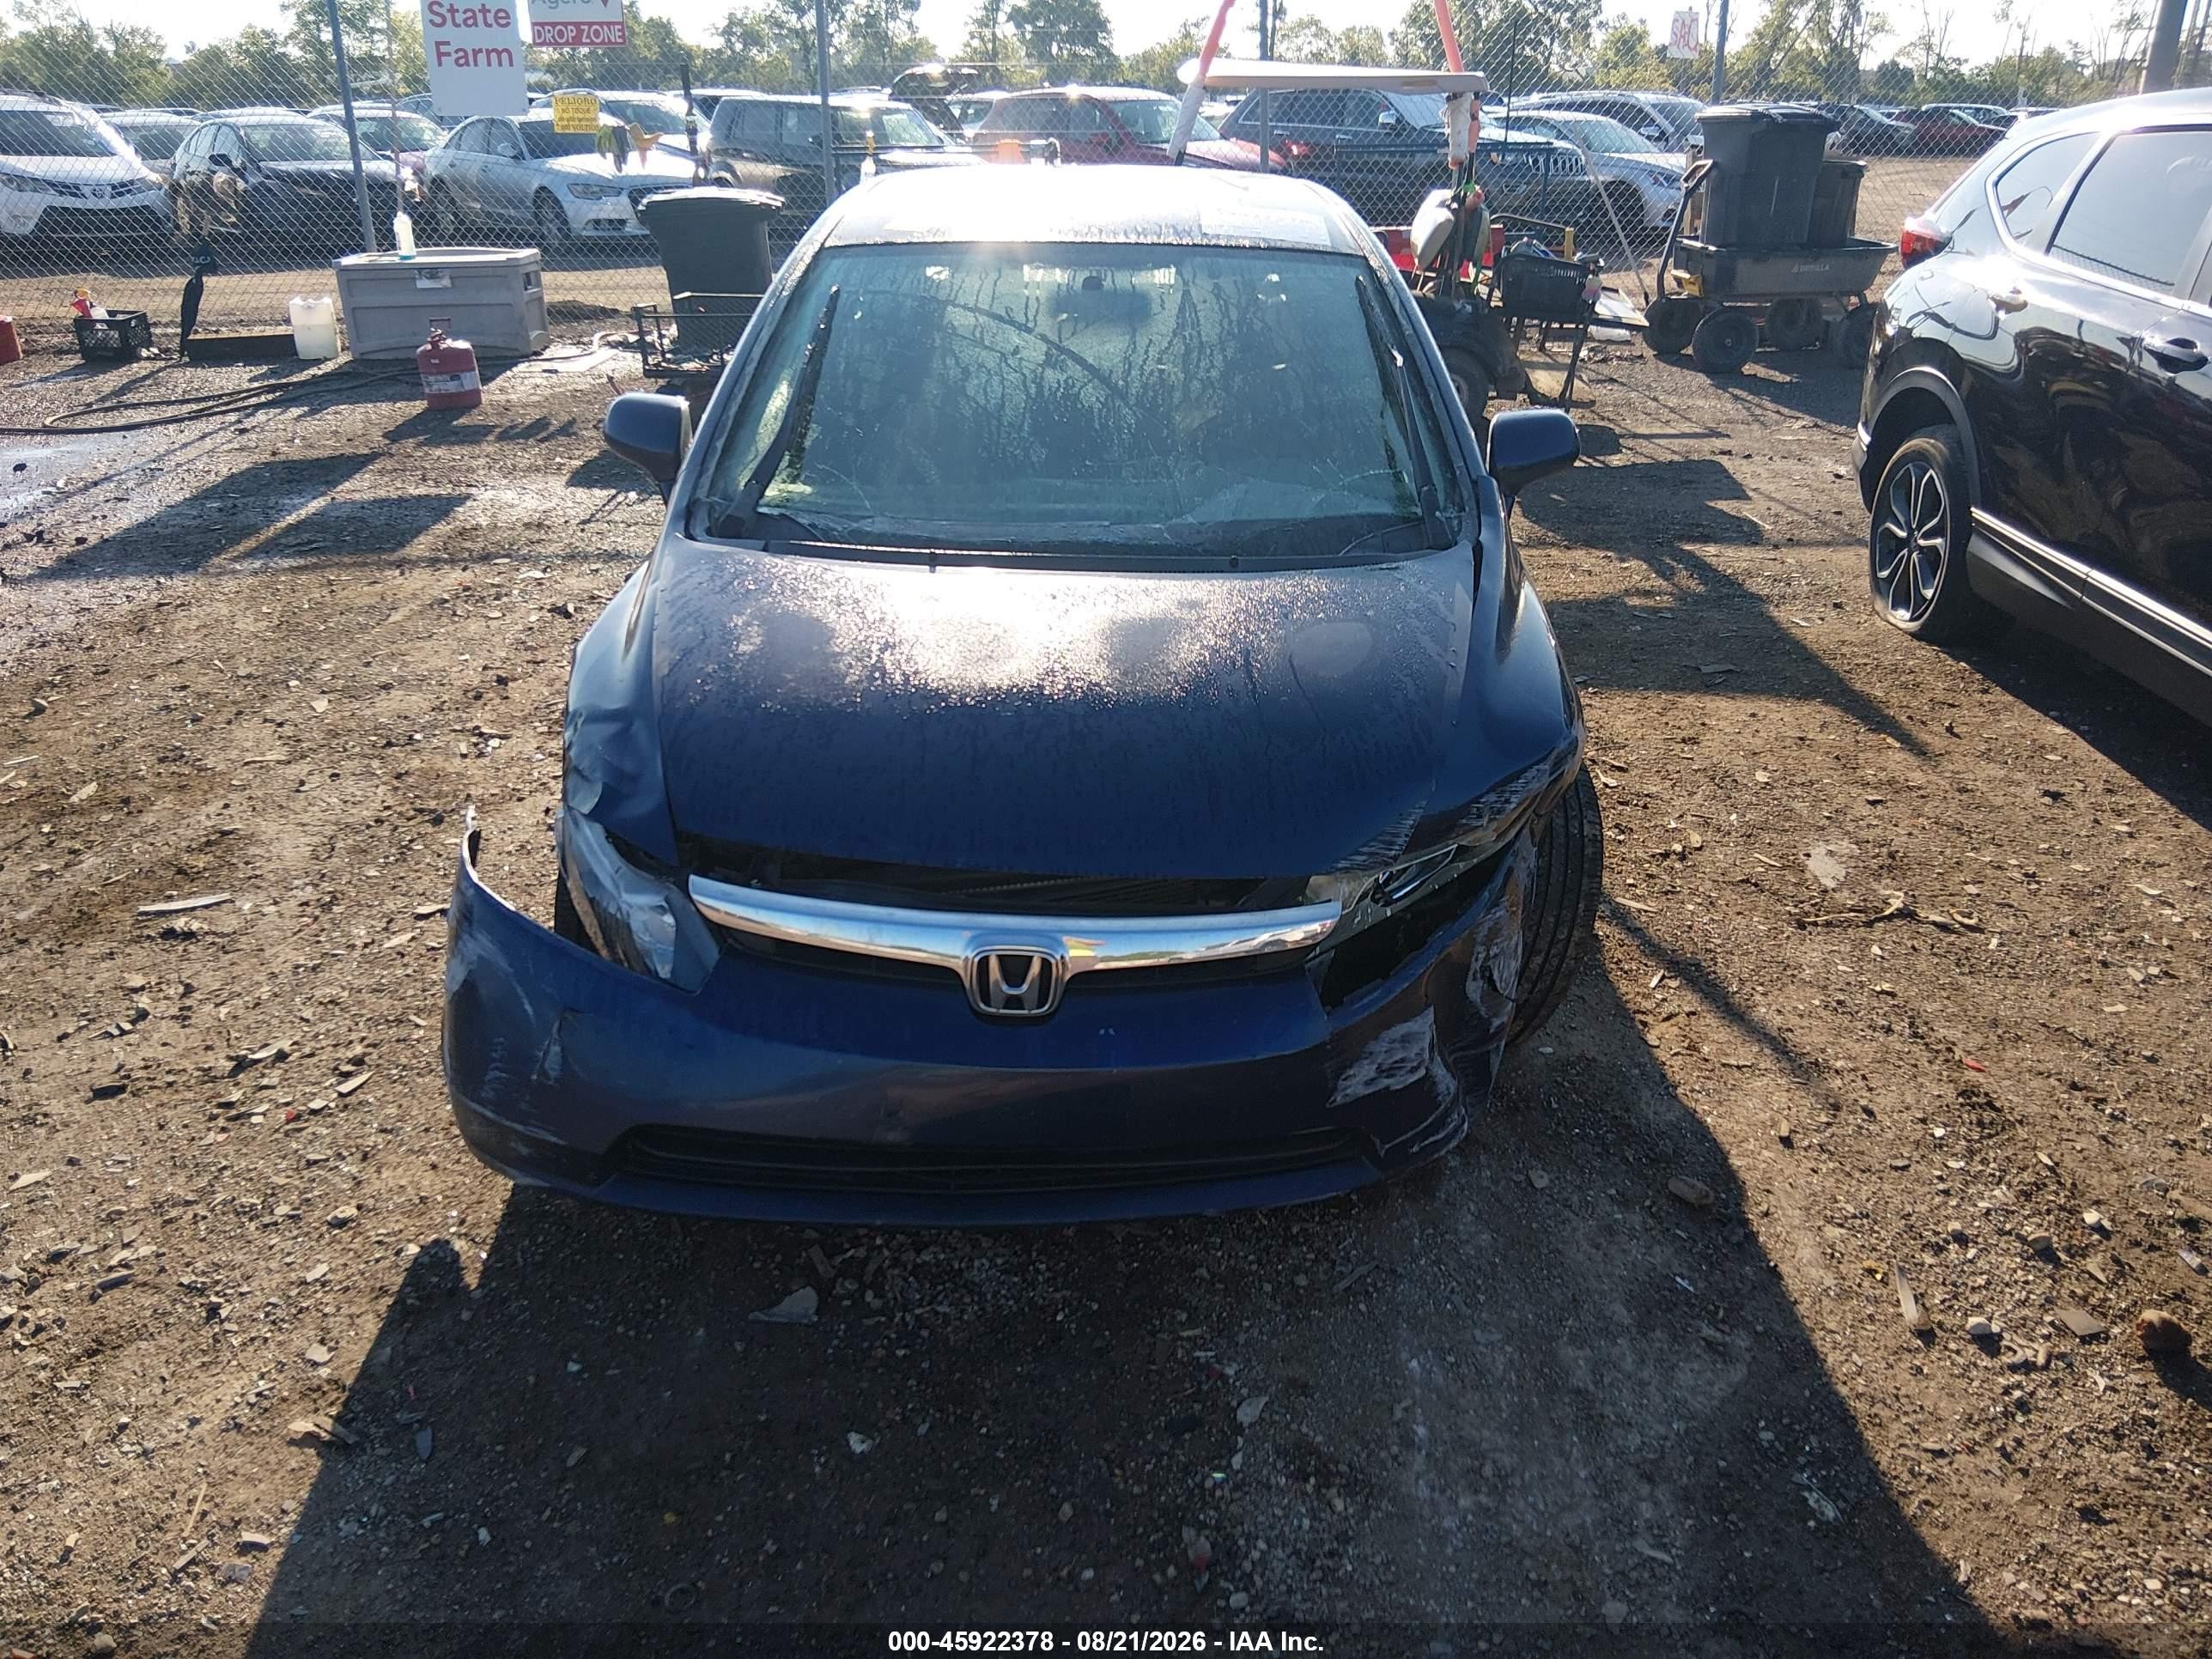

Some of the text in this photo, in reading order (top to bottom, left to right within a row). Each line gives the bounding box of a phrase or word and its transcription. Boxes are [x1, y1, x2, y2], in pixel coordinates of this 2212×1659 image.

[427, 0, 511, 28] State
[533, 24, 624, 43] DROP ZONE
[434, 40, 514, 68] Farm
